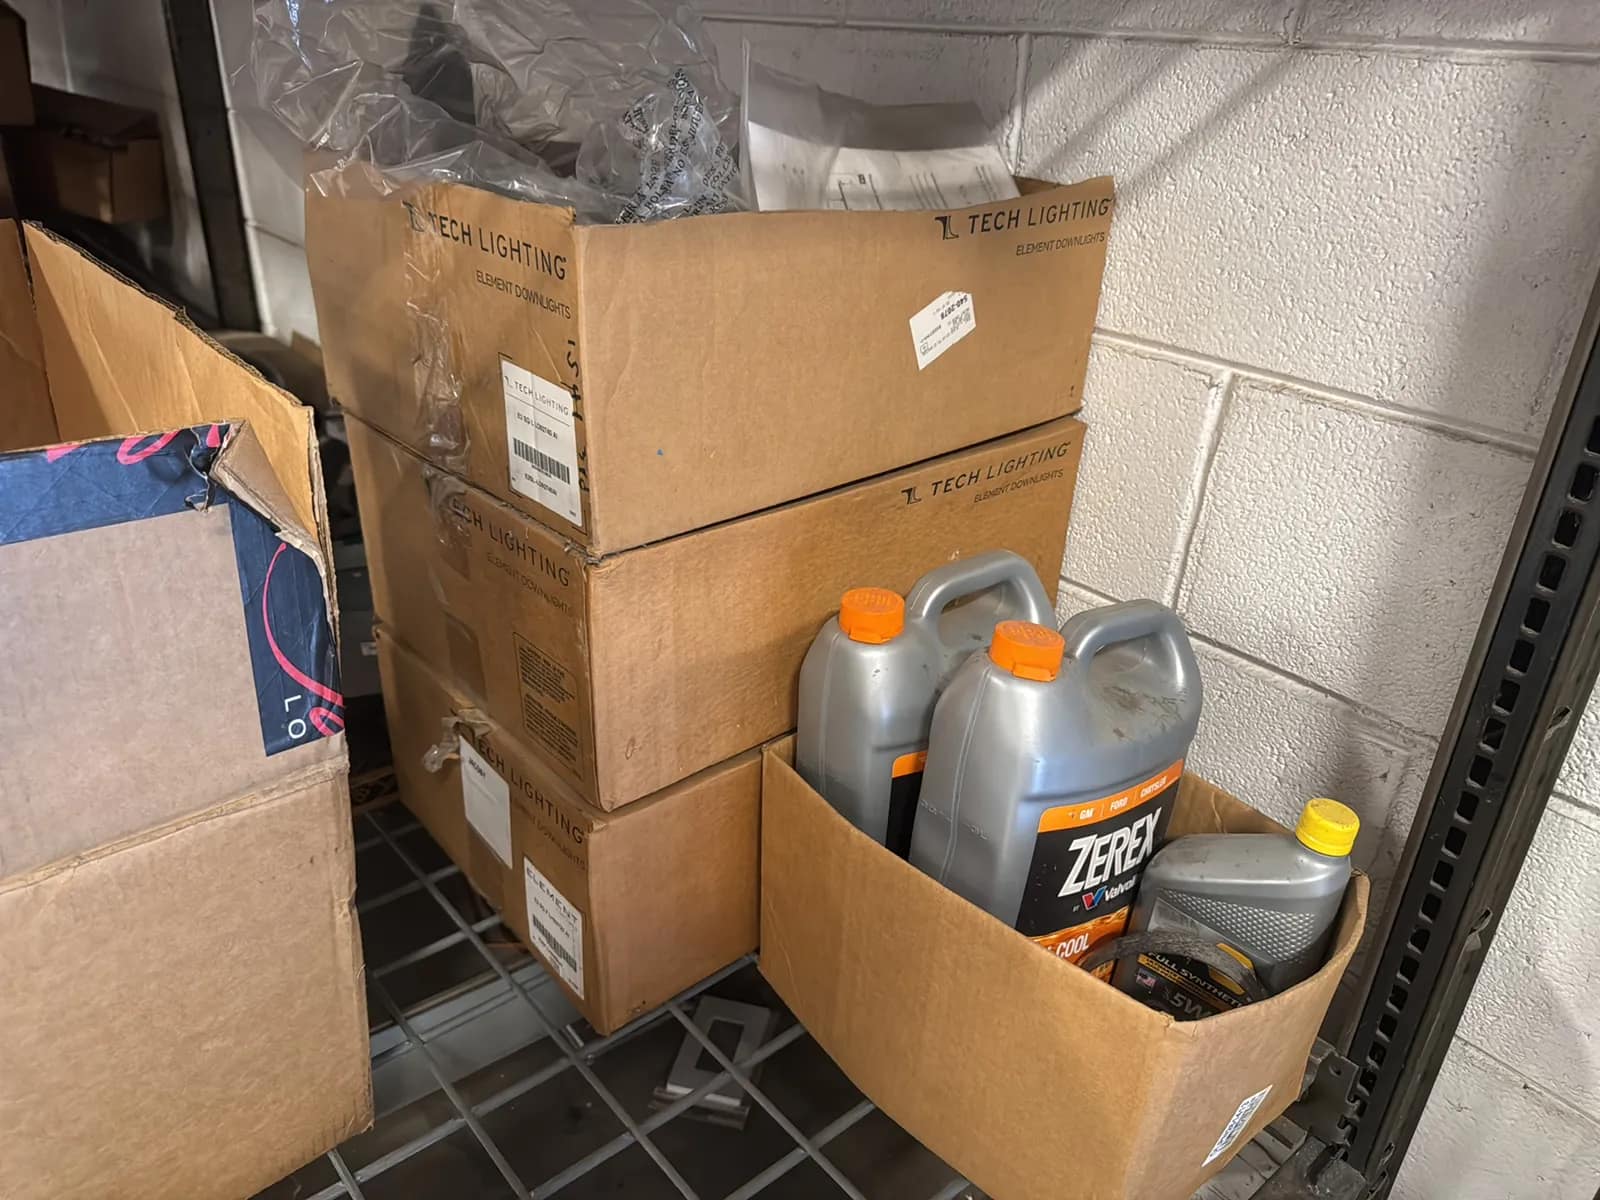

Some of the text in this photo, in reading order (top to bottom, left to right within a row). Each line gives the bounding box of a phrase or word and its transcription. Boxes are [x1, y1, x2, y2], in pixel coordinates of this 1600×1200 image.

[967, 208, 1021, 235] TECH
[1027, 198, 1112, 227] LIGHTING
[428, 210, 567, 280] TECH LIGHTING
[1015, 231, 1106, 257] ELEMENT DOWNLIGHTS
[476, 269, 572, 320] ELEMENT DOWNLIGHTS
[514, 380, 570, 417] TECH LIGHTING
[931, 468, 981, 497] TECH
[986, 442, 1068, 481] LIGHTING
[973, 468, 1064, 504] ELEMENT DOWNLIGHTS
[488, 522, 570, 587] LIGHTING
[511, 766, 585, 845] LIGHTING
[1079, 807, 1095, 820] GM
[1110, 796, 1129, 812] FORD
[1057, 807, 1162, 898] ZEREX
[526, 866, 579, 924] ELEMENT
[1104, 873, 1137, 902] Valvol
[1055, 933, 1090, 958] COOL
[1148, 951, 1178, 972] FULL
[1169, 991, 1206, 1020] 5W
